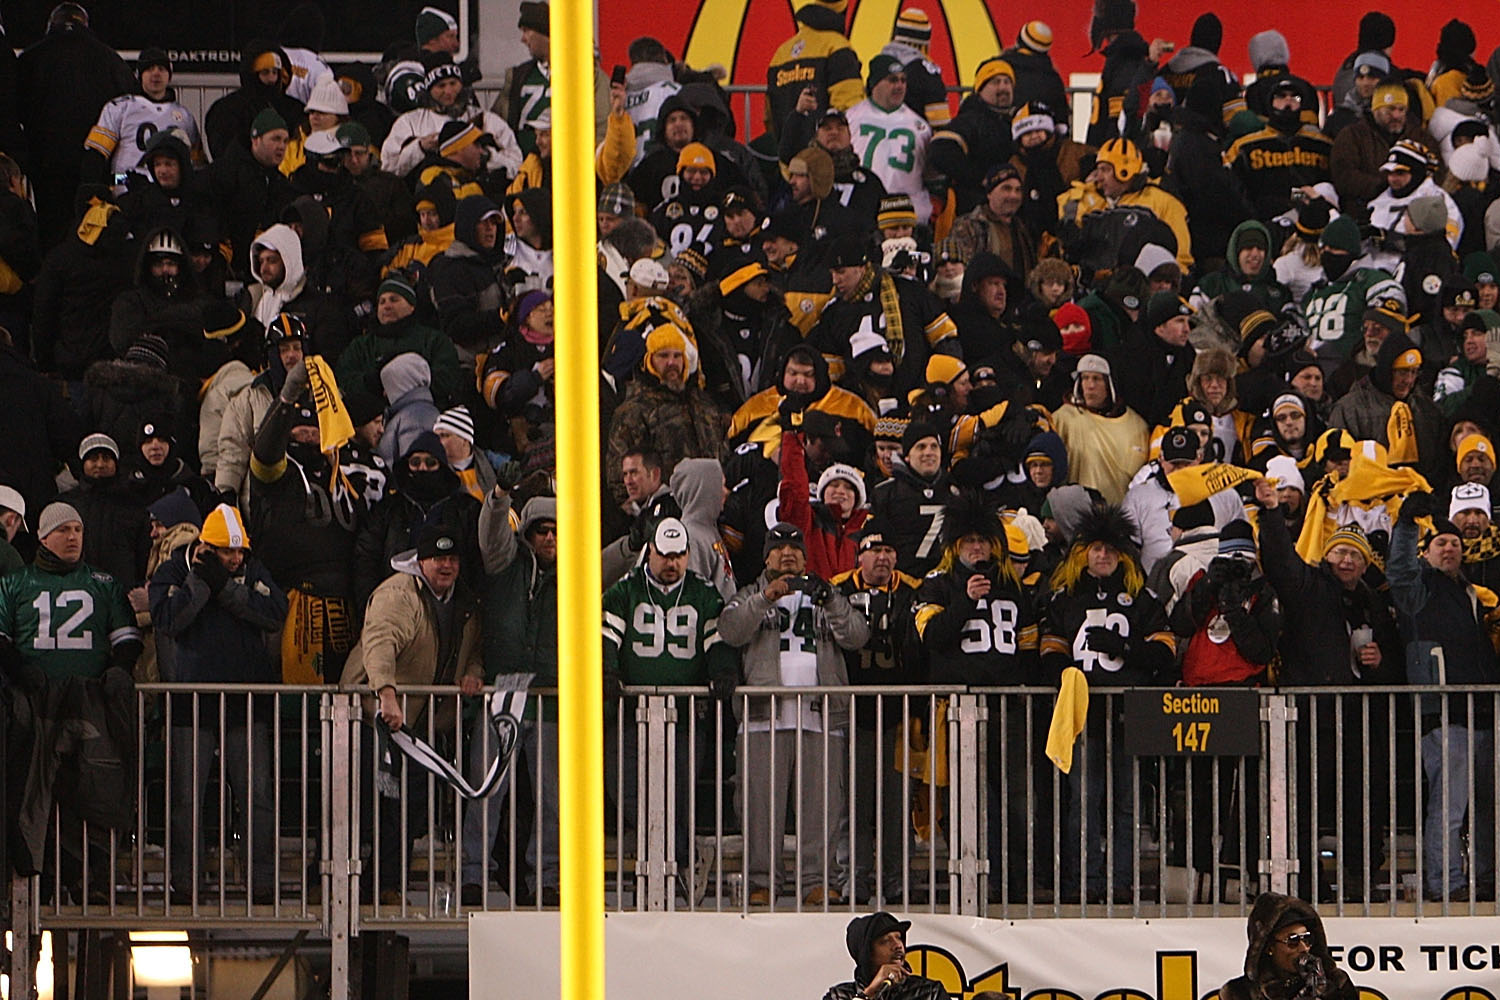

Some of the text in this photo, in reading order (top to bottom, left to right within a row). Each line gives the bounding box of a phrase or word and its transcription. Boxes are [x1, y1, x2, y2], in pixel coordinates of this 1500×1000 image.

[860, 124, 916, 173] 73
[1250, 146, 1329, 171] Steelers
[914, 504, 948, 559] 7
[32, 590, 94, 650] 12
[632, 602, 699, 661] 99
[960, 597, 1019, 656] 58
[1162, 692, 1221, 714] Section
[1172, 721, 1212, 752] 147
[1329, 945, 1406, 972] FOR
